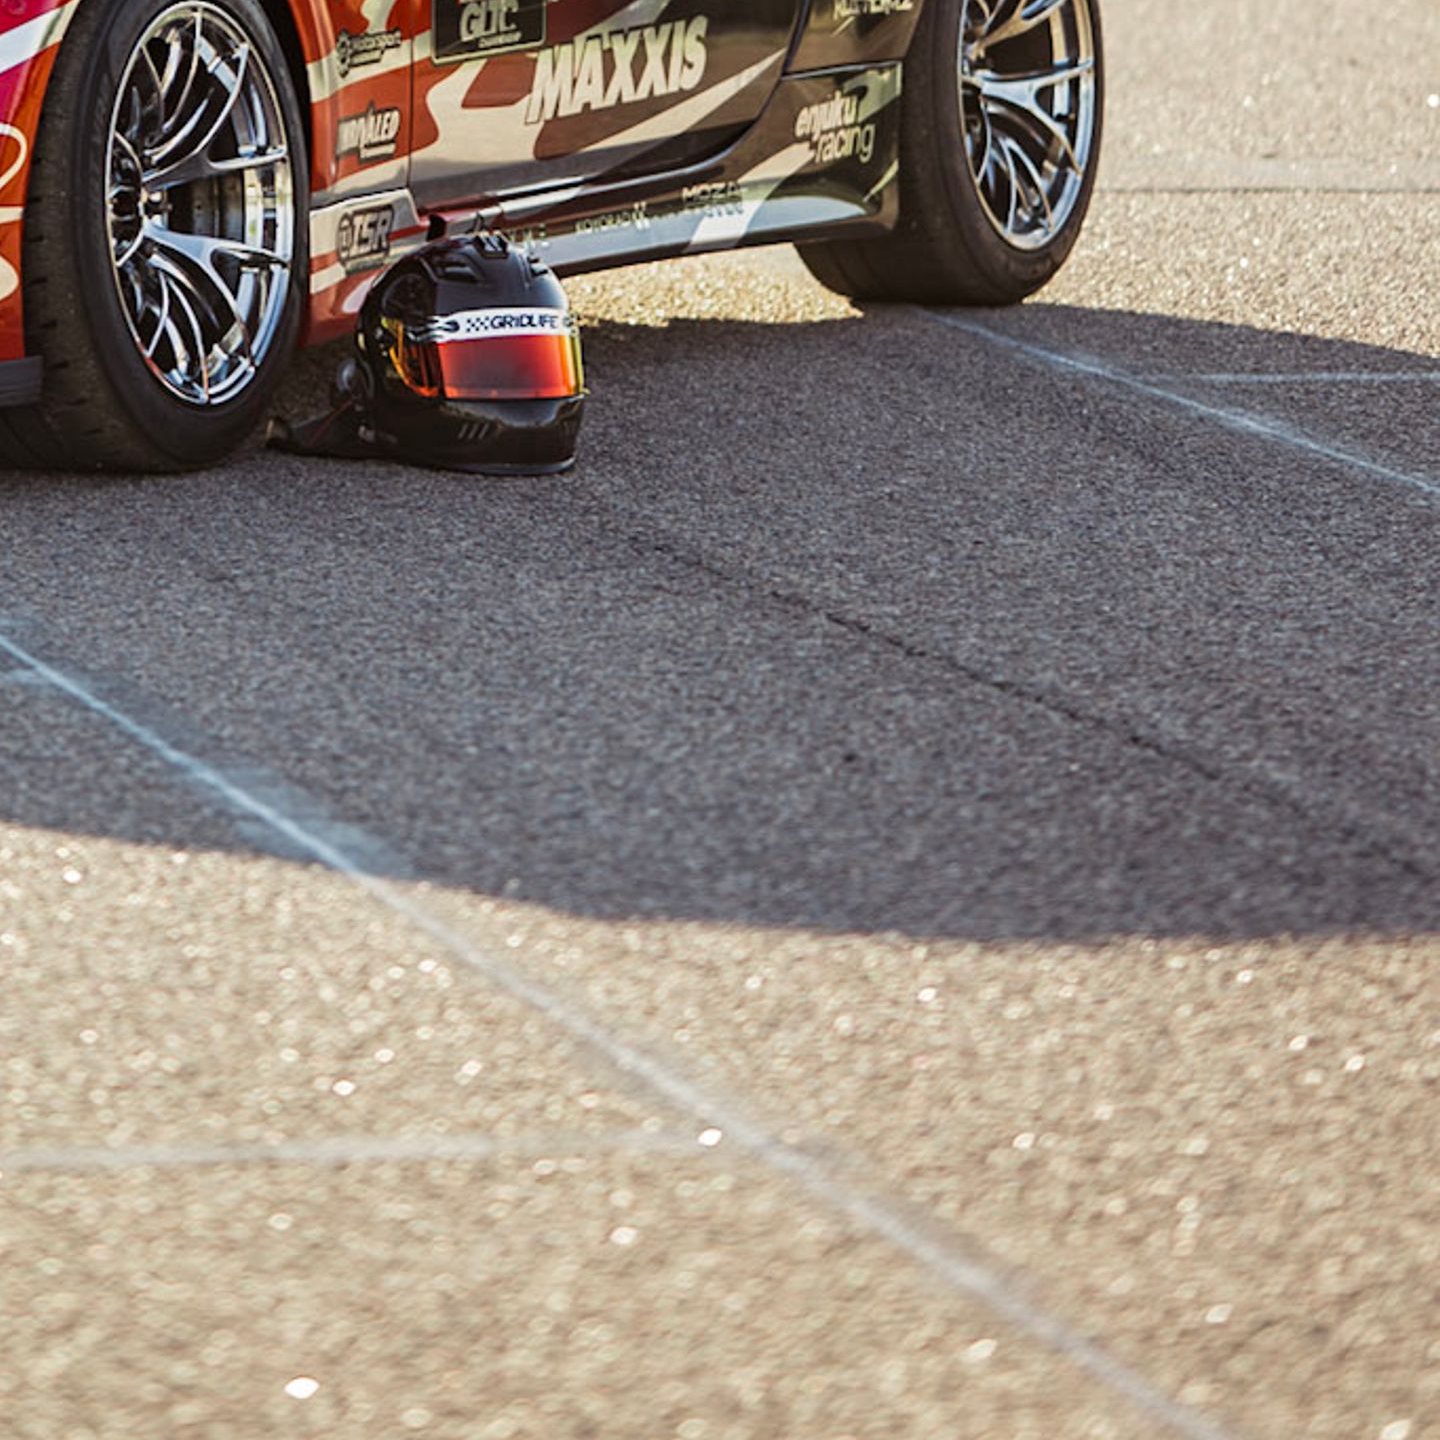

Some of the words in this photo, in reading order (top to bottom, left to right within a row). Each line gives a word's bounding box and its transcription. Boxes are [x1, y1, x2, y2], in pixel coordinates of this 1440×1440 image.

[525, 15, 709, 125] MAXXIS
[815, 124, 876, 163] racing
[490, 313, 559, 330] GRIDLIFE
